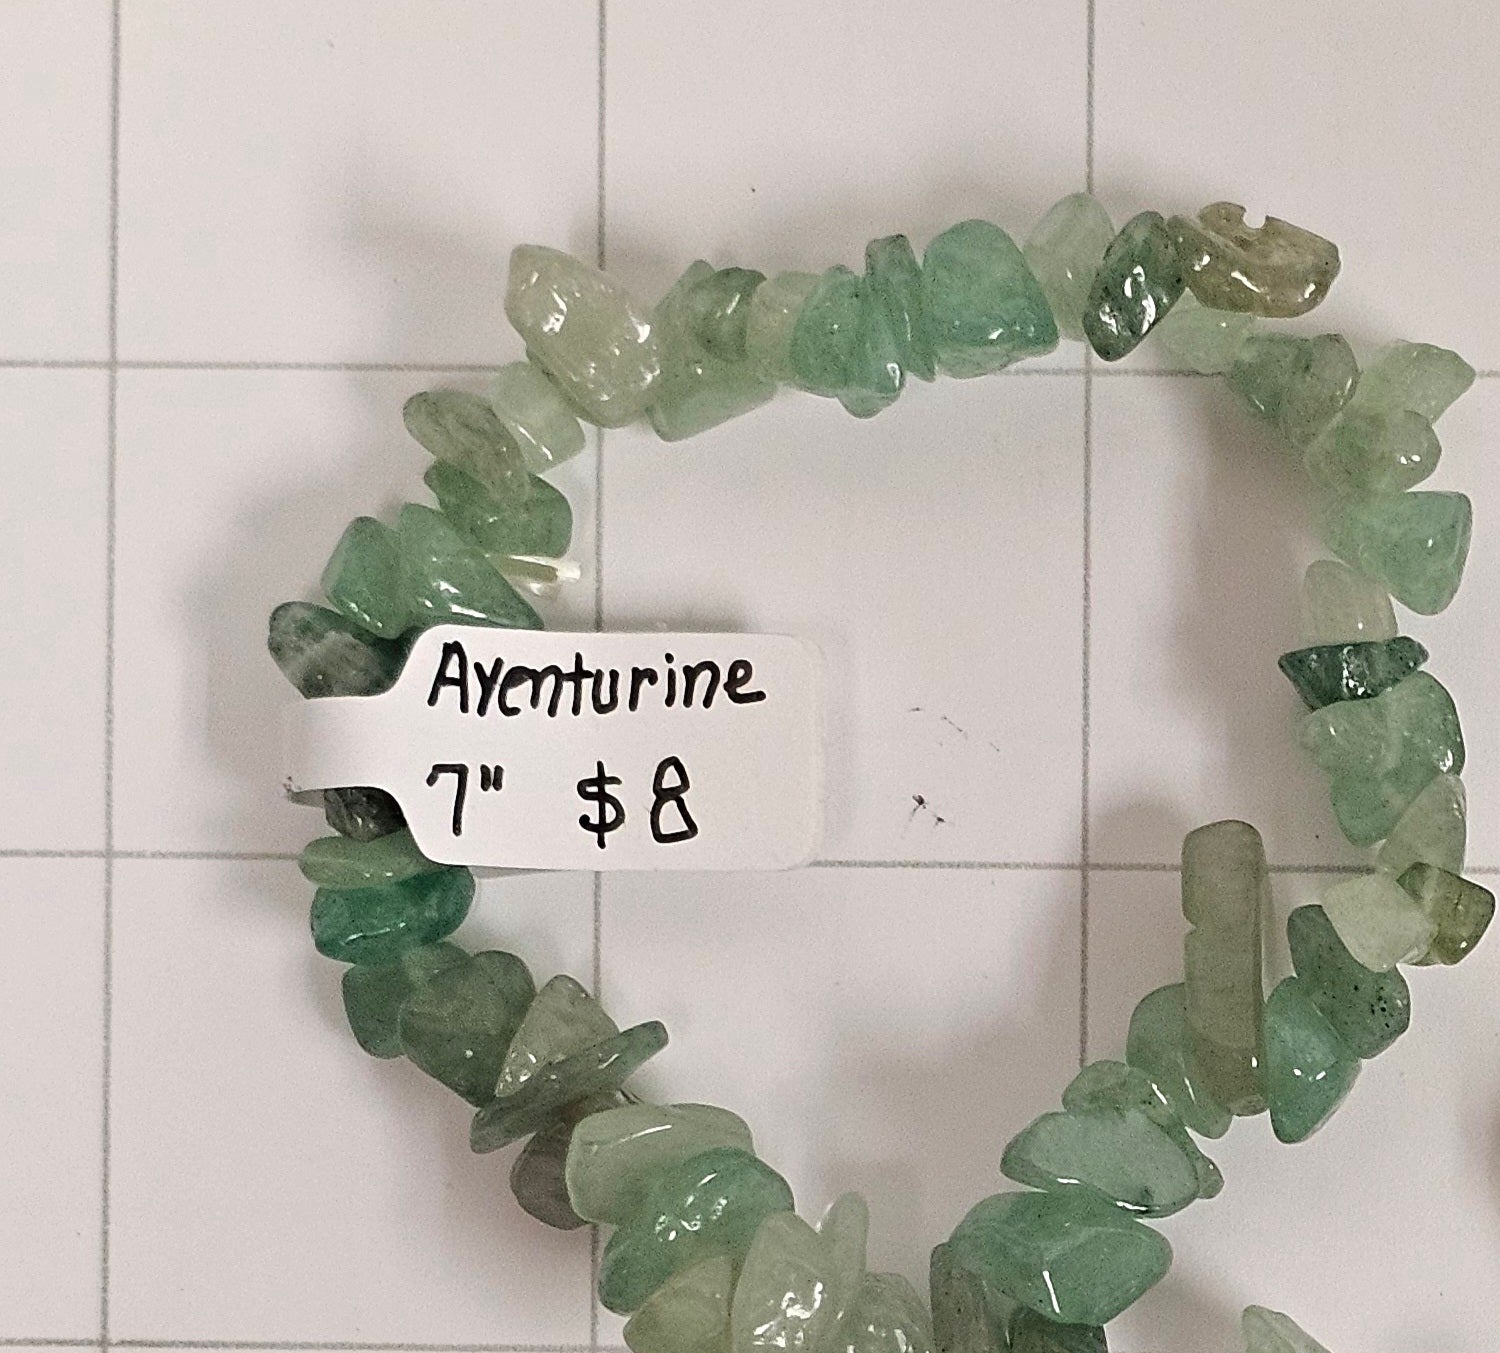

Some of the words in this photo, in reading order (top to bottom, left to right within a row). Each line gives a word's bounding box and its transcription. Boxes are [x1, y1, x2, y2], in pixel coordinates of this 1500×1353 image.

[426, 639, 768, 719] Aventurine
[425, 762, 505, 838] 7"
[575, 754, 700, 851] $8
